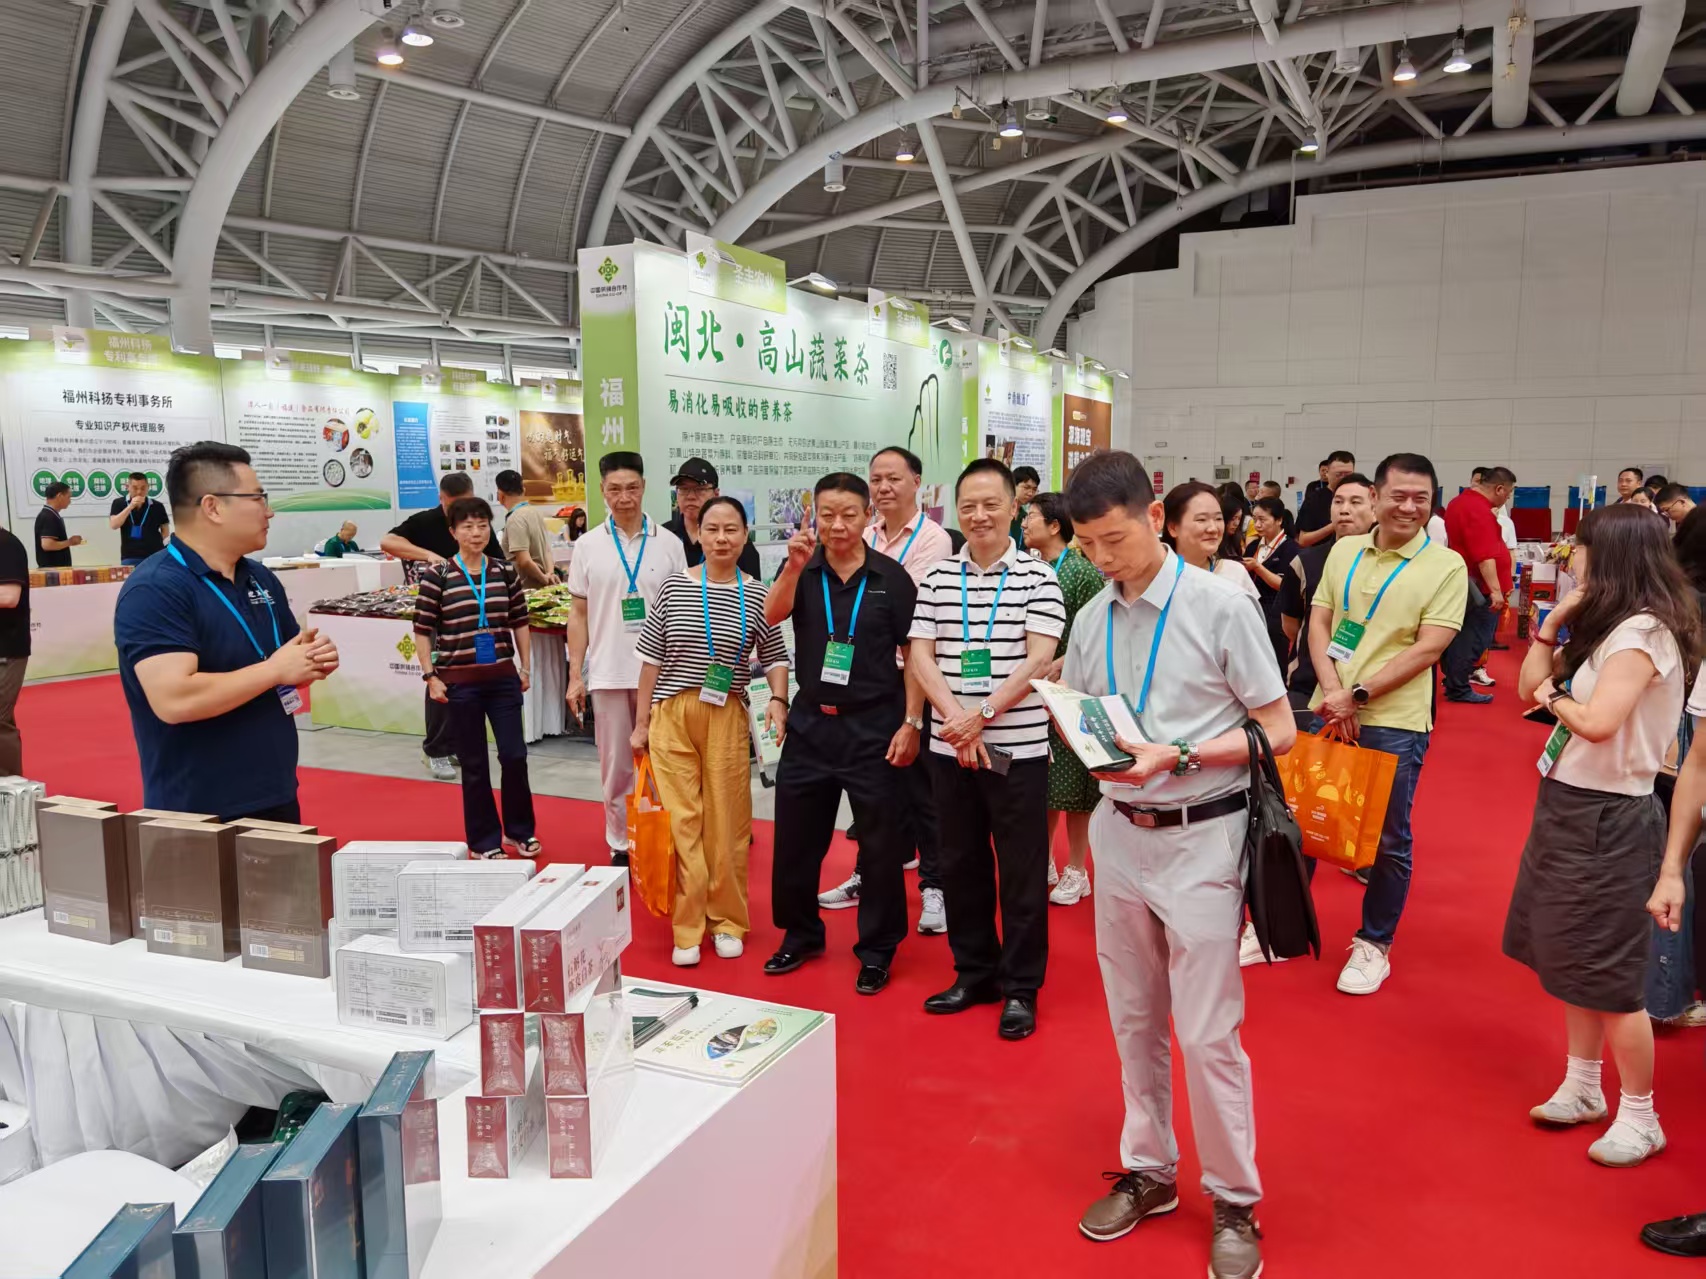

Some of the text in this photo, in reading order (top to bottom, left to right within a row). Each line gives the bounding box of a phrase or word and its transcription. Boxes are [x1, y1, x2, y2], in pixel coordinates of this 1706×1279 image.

[62, 389, 173, 409] 福州科扬专利事务所
[668, 388, 793, 423] 易消化易吸收的营养茶
[75, 419, 166, 433] 专业知识产权代理服务
